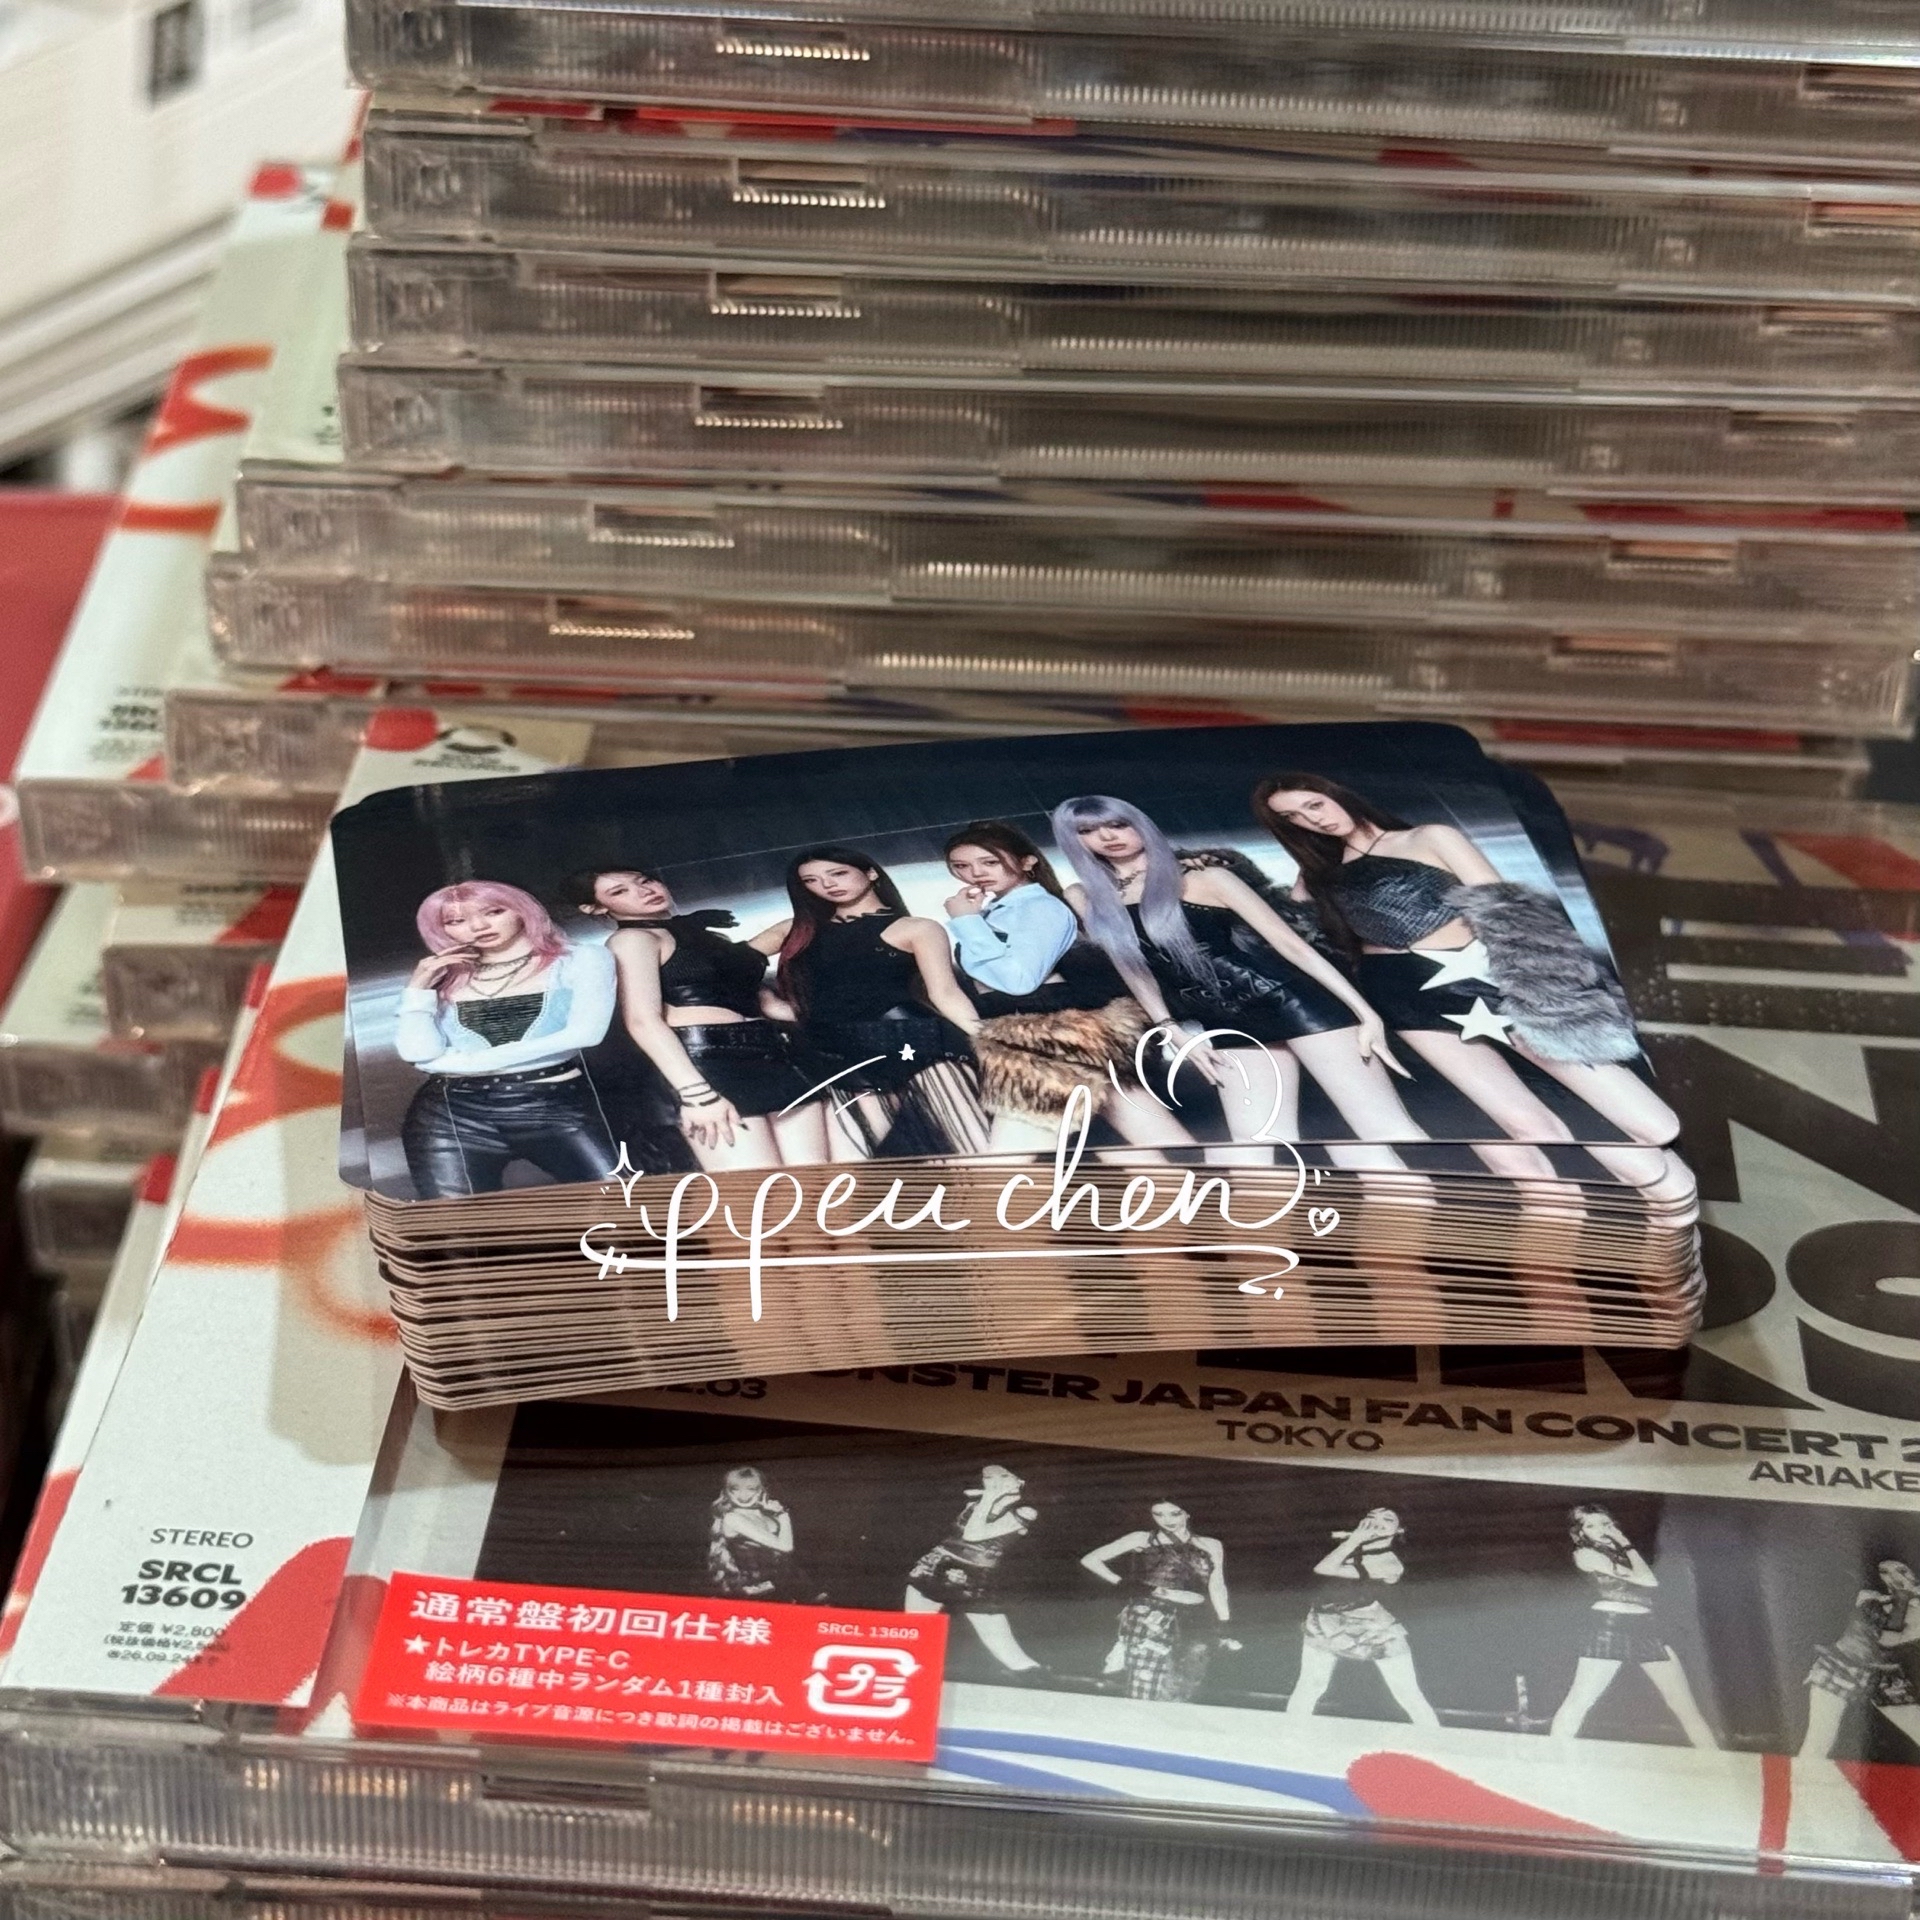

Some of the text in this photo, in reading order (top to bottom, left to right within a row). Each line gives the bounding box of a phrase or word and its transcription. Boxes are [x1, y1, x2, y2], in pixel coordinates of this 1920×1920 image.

[1111, 1379, 1352, 1421] JAPAN
[1366, 1399, 1512, 1435] FAN
[1525, 1411, 1888, 1461] CONCERT
[1216, 1419, 1385, 1451] TOKYO
[1748, 1460, 1920, 1493] ARIAKE
[151, 1528, 254, 1549] STEREO
[138, 1559, 243, 1585] SRCL
[121, 1584, 247, 1611] 13609
[409, 1591, 772, 1646] 通常盤初回仕様
[817, 1622, 920, 1640] SRCL 13609
[423, 1660, 783, 1707] 絵柄6種中ランダム1種封入
[833, 1662, 908, 1700] プラ
